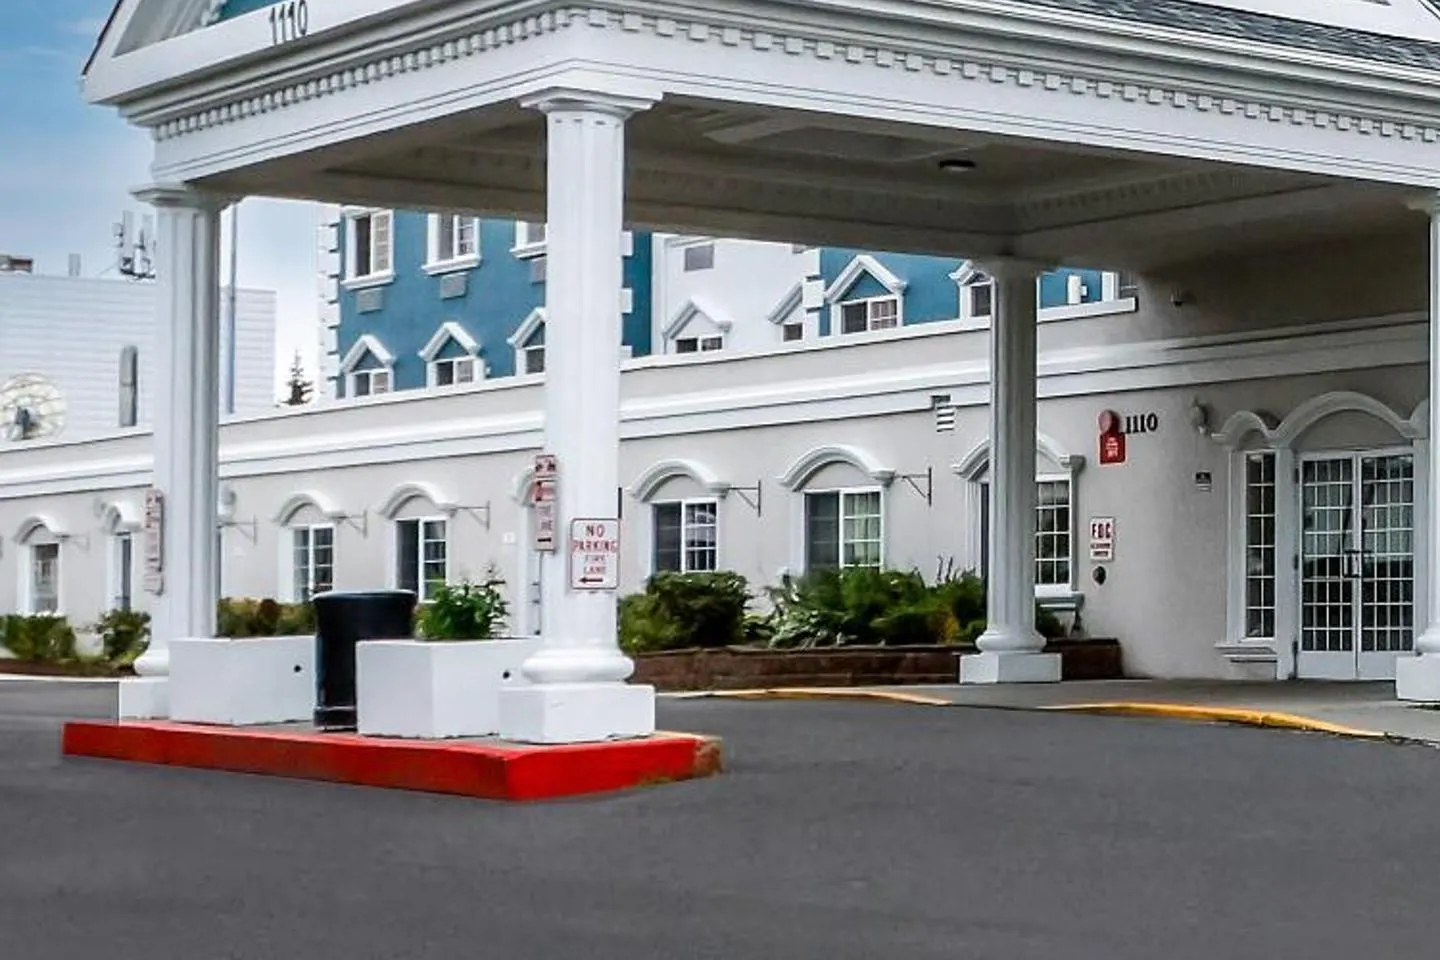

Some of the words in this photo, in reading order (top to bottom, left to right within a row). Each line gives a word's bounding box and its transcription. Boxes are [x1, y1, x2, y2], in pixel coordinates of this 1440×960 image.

[1125, 412, 1159, 435] 1110
[585, 524, 606, 538] NO
[571, 539, 618, 553] PARKING
